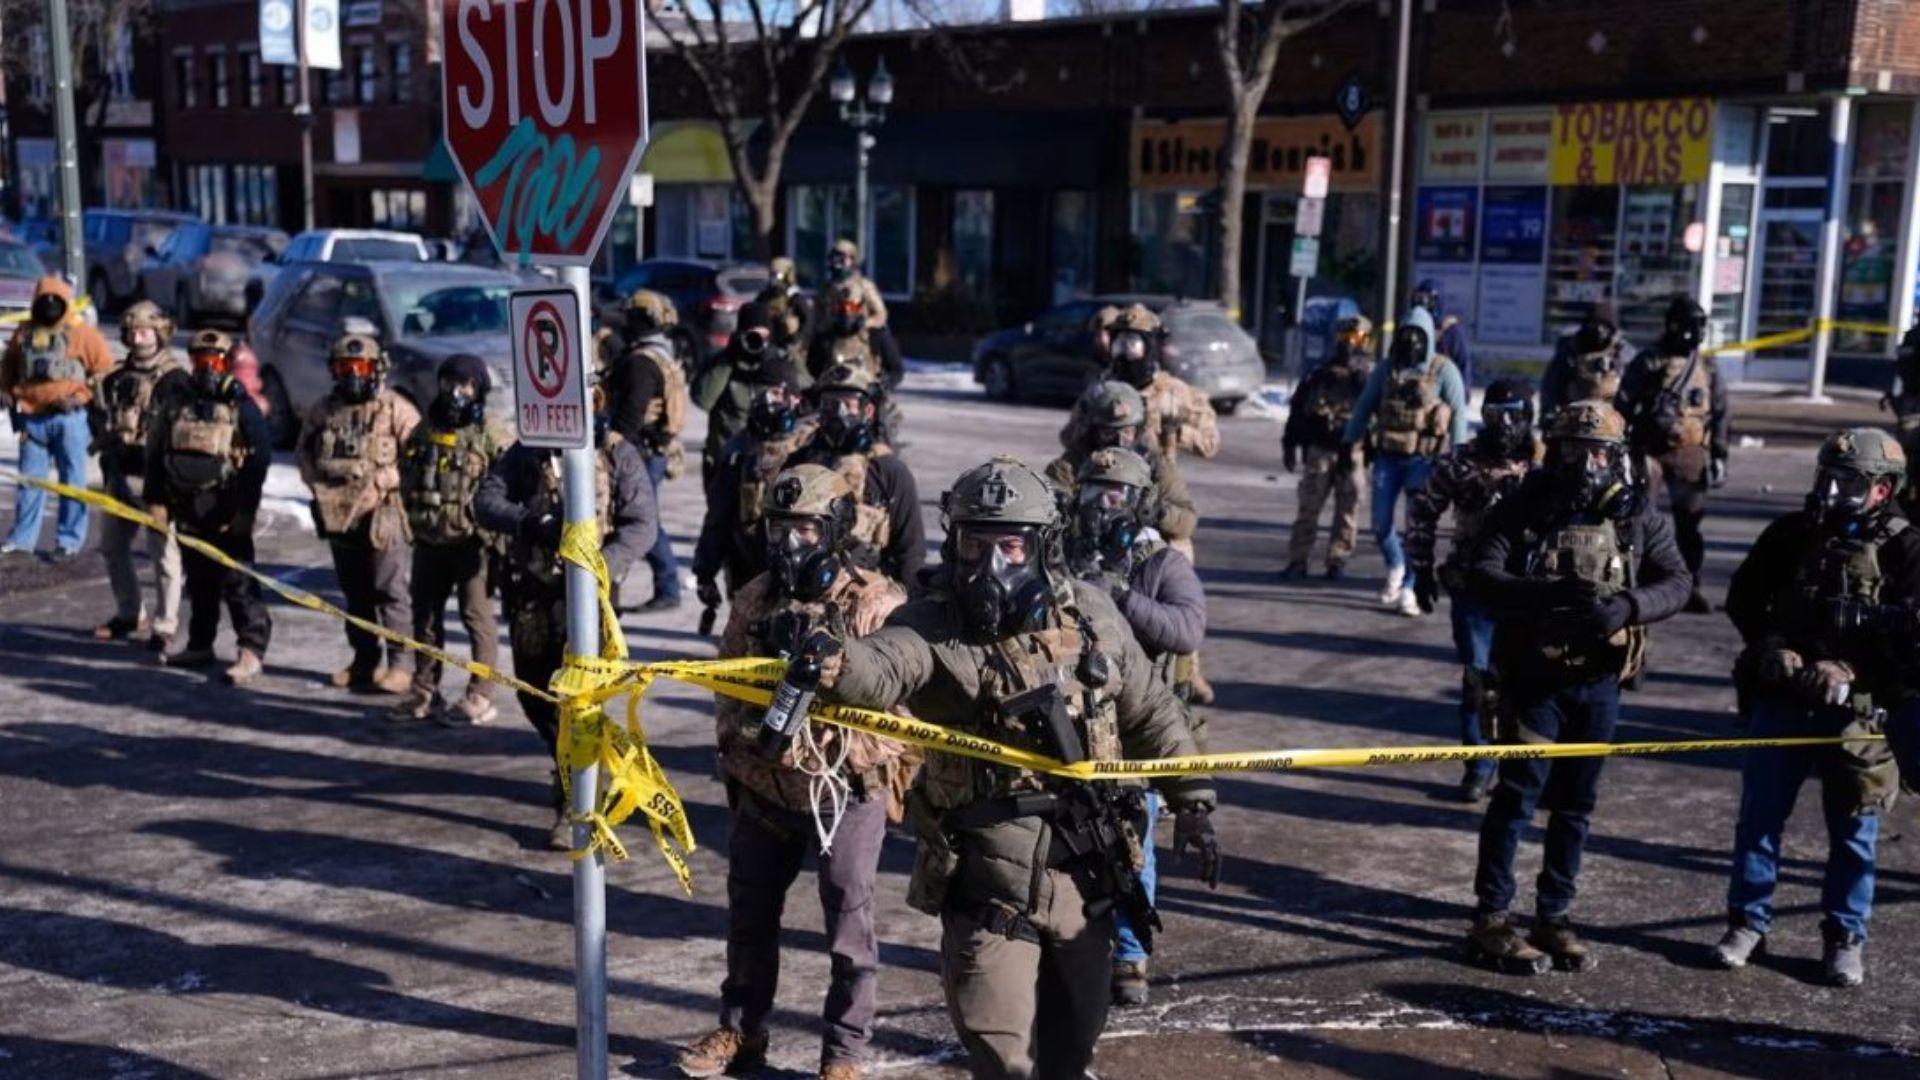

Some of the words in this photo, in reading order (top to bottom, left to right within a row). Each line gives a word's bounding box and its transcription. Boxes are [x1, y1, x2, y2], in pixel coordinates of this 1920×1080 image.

[457, 0, 622, 129] STOP
[1557, 99, 1709, 144] TOBACCO
[1576, 145, 1598, 184] &
[1612, 139, 1682, 184] MAS
[523, 403, 540, 433] 30
[546, 404, 578, 433] FEET
[833, 706, 873, 726] LINE
[875, 717, 900, 732] DO
[904, 724, 942, 741] NOT
